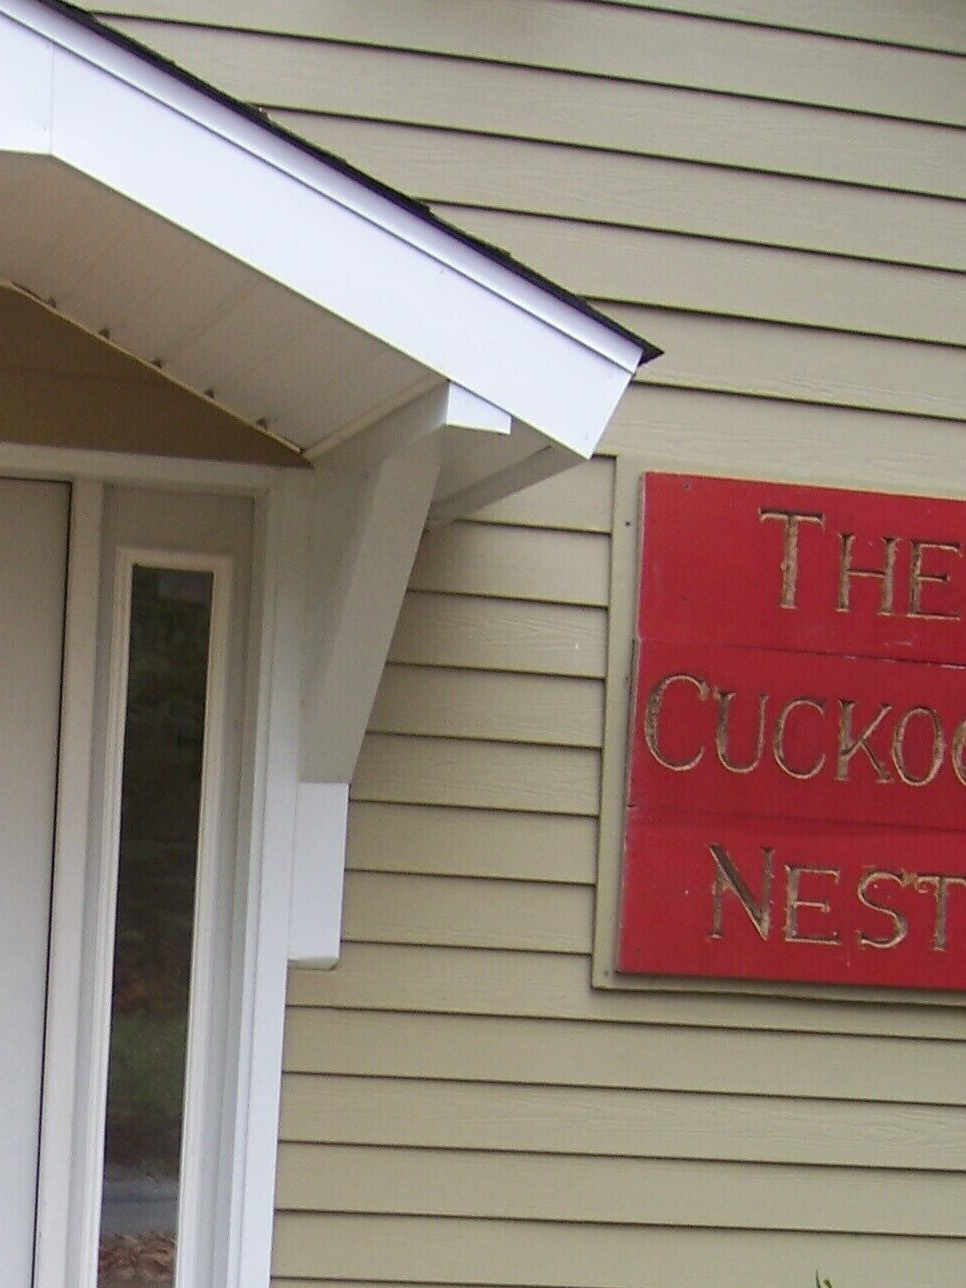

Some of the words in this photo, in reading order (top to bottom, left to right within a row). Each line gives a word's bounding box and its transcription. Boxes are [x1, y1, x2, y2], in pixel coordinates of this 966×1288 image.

[757, 507, 963, 621] THE
[643, 672, 966, 787] CUCKO
[706, 842, 966, 951] NEST
